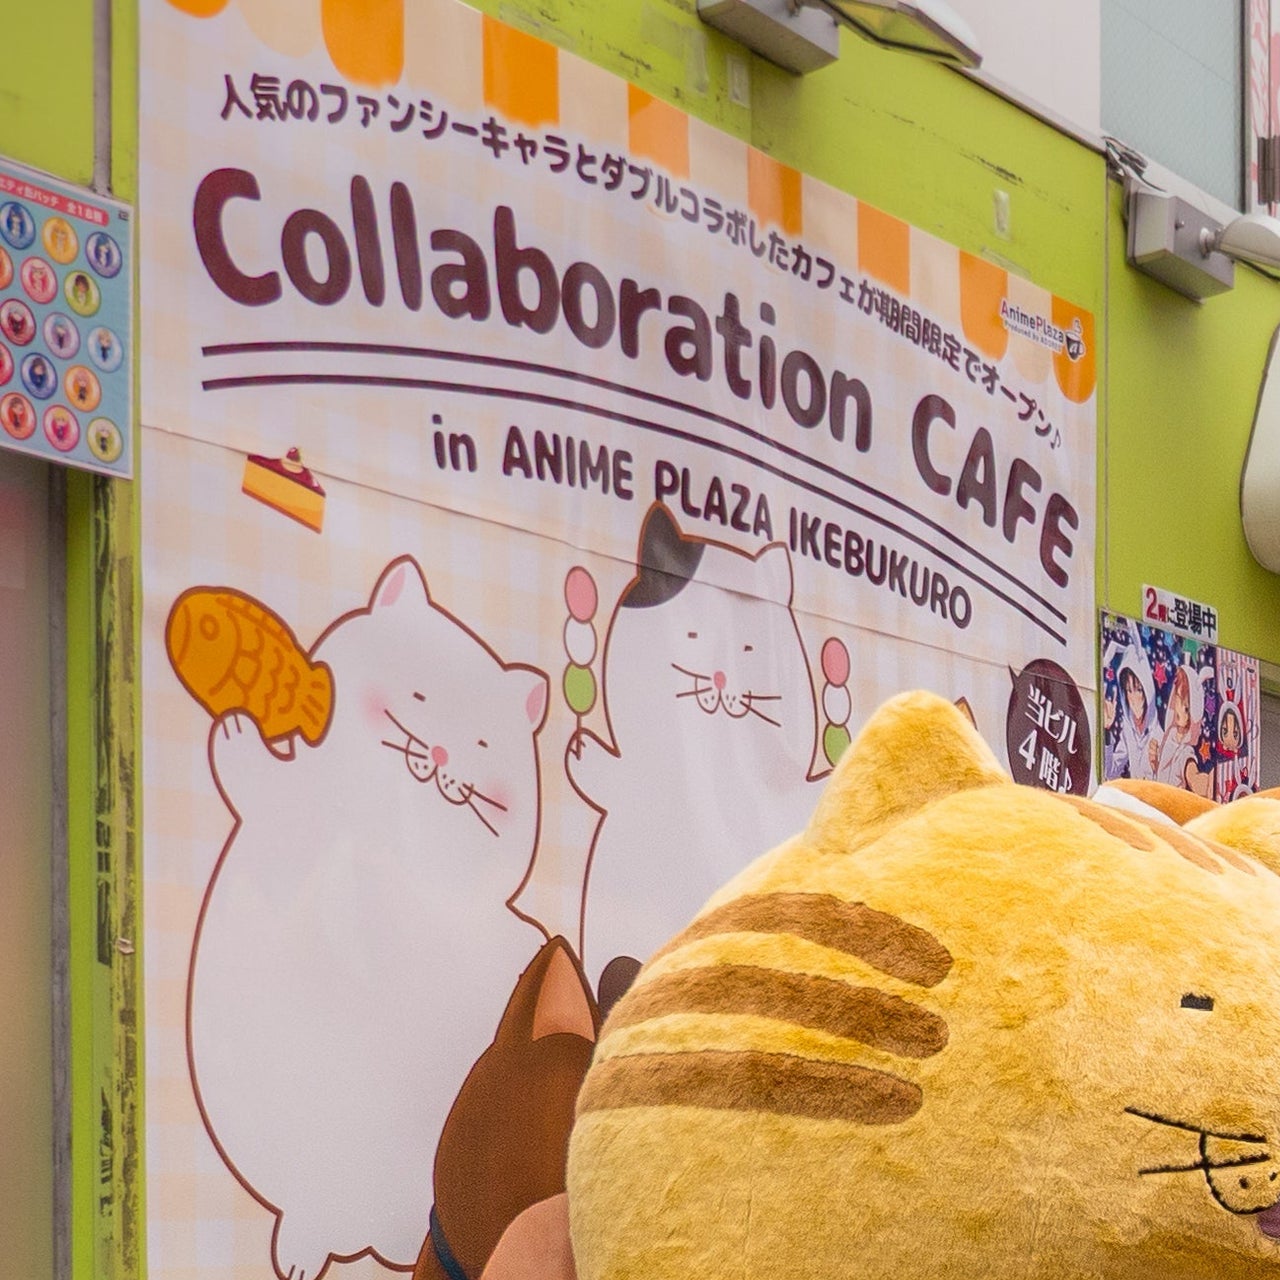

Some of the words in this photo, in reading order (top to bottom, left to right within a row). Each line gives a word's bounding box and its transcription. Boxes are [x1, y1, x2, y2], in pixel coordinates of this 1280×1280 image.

[193, 167, 873, 454] Collaboration
[911, 393, 1080, 589] CAFE
[431, 412, 478, 473] in
[502, 424, 634, 501] ANIME
[655, 459, 774, 541] PLAZA
[789, 507, 972, 630] IKEBUKURO
[1018, 729, 1061, 793] 4階
[1025, 683, 1078, 755] 当ビル
